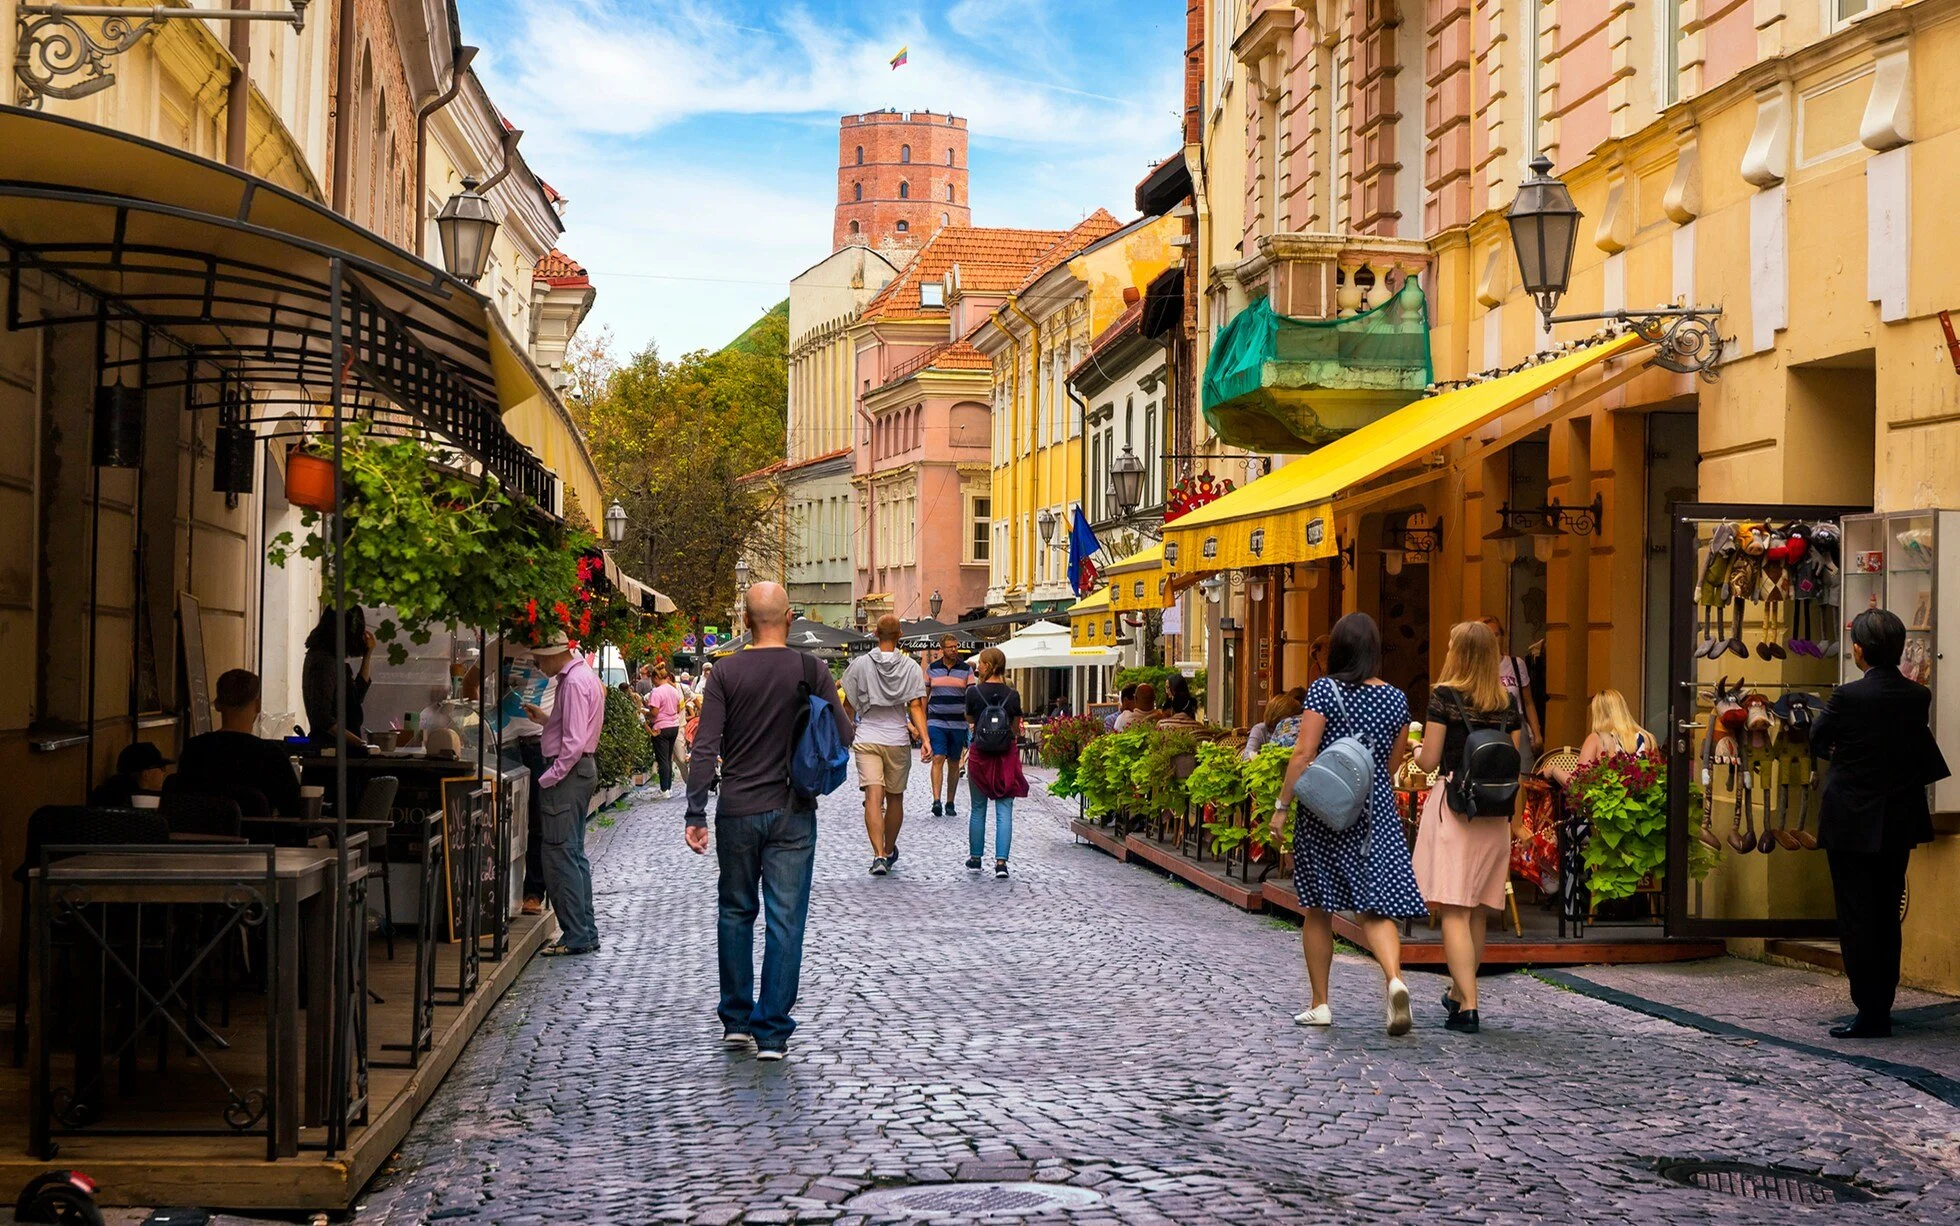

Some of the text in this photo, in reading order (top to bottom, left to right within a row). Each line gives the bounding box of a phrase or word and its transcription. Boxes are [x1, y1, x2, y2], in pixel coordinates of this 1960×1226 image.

[898, 639, 928, 649] Pilies
[930, 640, 976, 649] KADĖLĖ
[1637, 875, 1650, 886] AS
